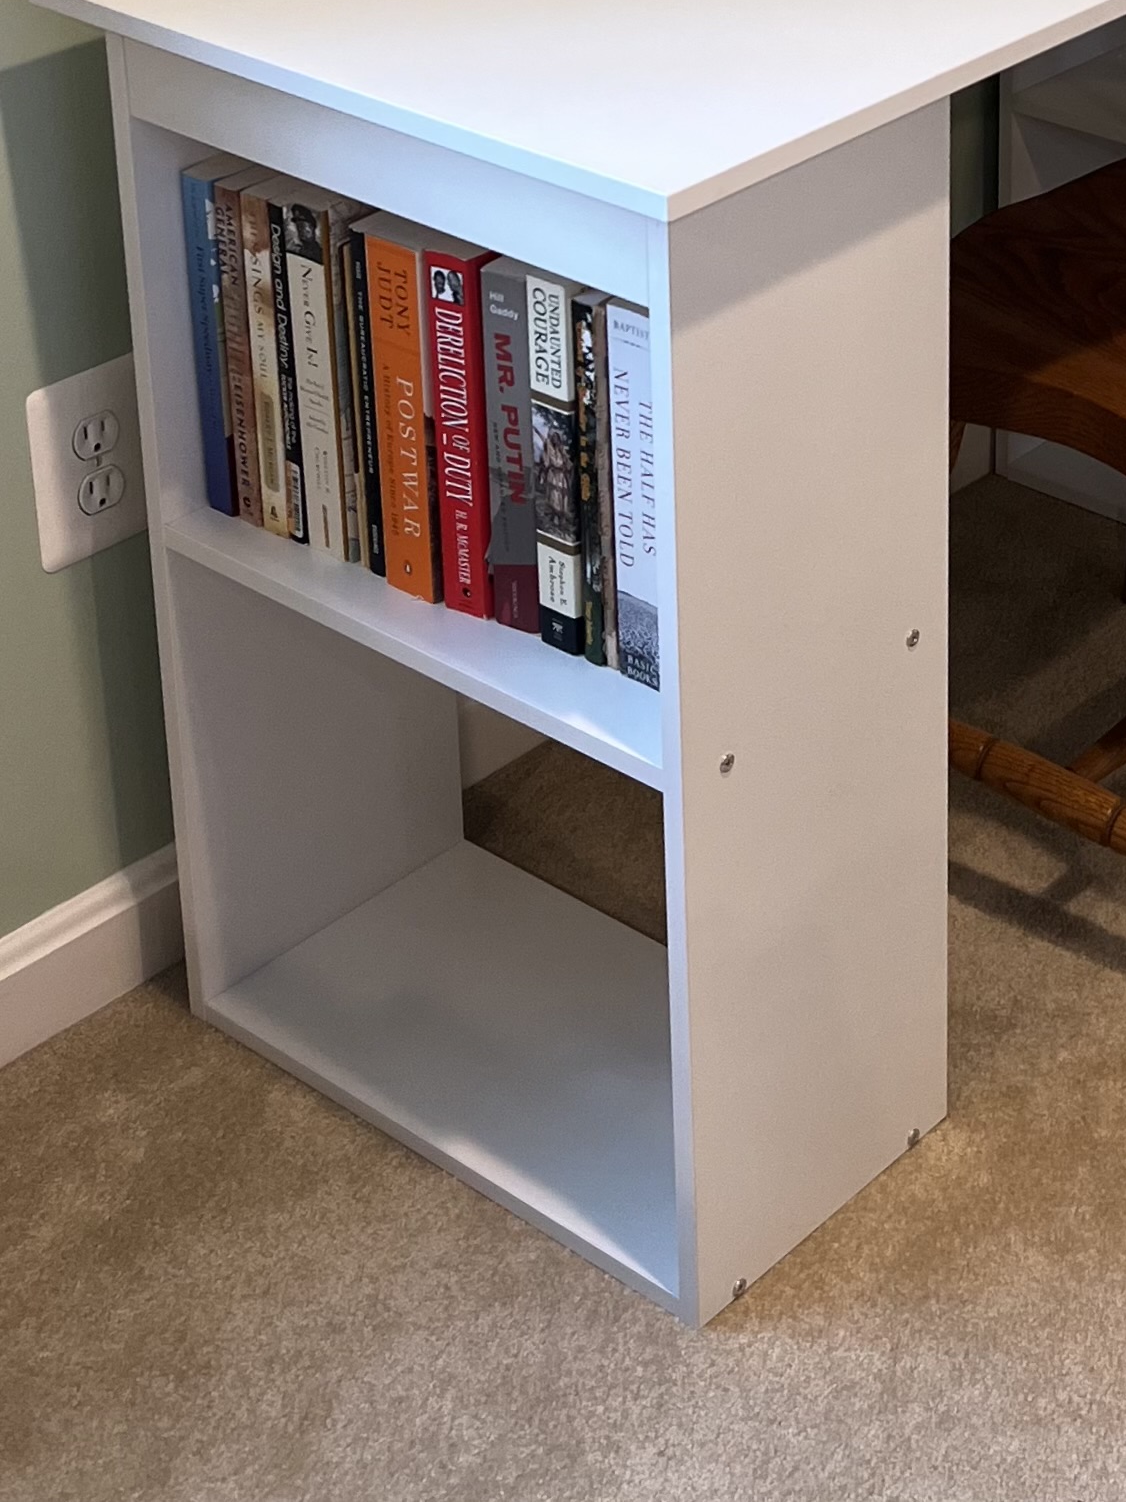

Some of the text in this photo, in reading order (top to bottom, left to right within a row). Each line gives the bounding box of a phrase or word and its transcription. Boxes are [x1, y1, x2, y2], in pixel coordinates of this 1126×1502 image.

[215, 206, 229, 275] GENERAL
[225, 204, 238, 285] AMERICAN
[271, 224, 282, 274] Design
[251, 255, 262, 314] SINGS
[258, 344, 268, 378] SOUL
[274, 279, 287, 311] and
[377, 261, 394, 329] JUDT
[394, 270, 411, 336] TONY
[489, 291, 505, 303] Hill
[489, 304, 519, 321] Gaddy
[532, 287, 550, 385] COURAGE
[548, 293, 562, 389] UNDAUNTED
[613, 319, 649, 340] BAPTIST
[359, 315, 368, 391] BUREAUCRATIC
[364, 395, 374, 474] ENTREPRENEUR
[383, 374, 393, 415] History
[385, 420, 394, 433] of
[434, 306, 474, 507] DERELICTION OF DUTY
[494, 332, 527, 505] MR. PUTIN
[233, 384, 250, 487] EISENHOWER
[386, 434, 396, 476] Europe
[397, 376, 421, 538] POSTWAR
[614, 367, 635, 567] NEVER BEEN TOLD
[638, 401, 657, 556] THE HALF HAS
[455, 509, 468, 519] H.
[548, 555, 556, 603] Ambrose
[557, 560, 567, 597] Stephen
[627, 653, 658, 674] BASIC
[627, 666, 658, 686] BOOKS
